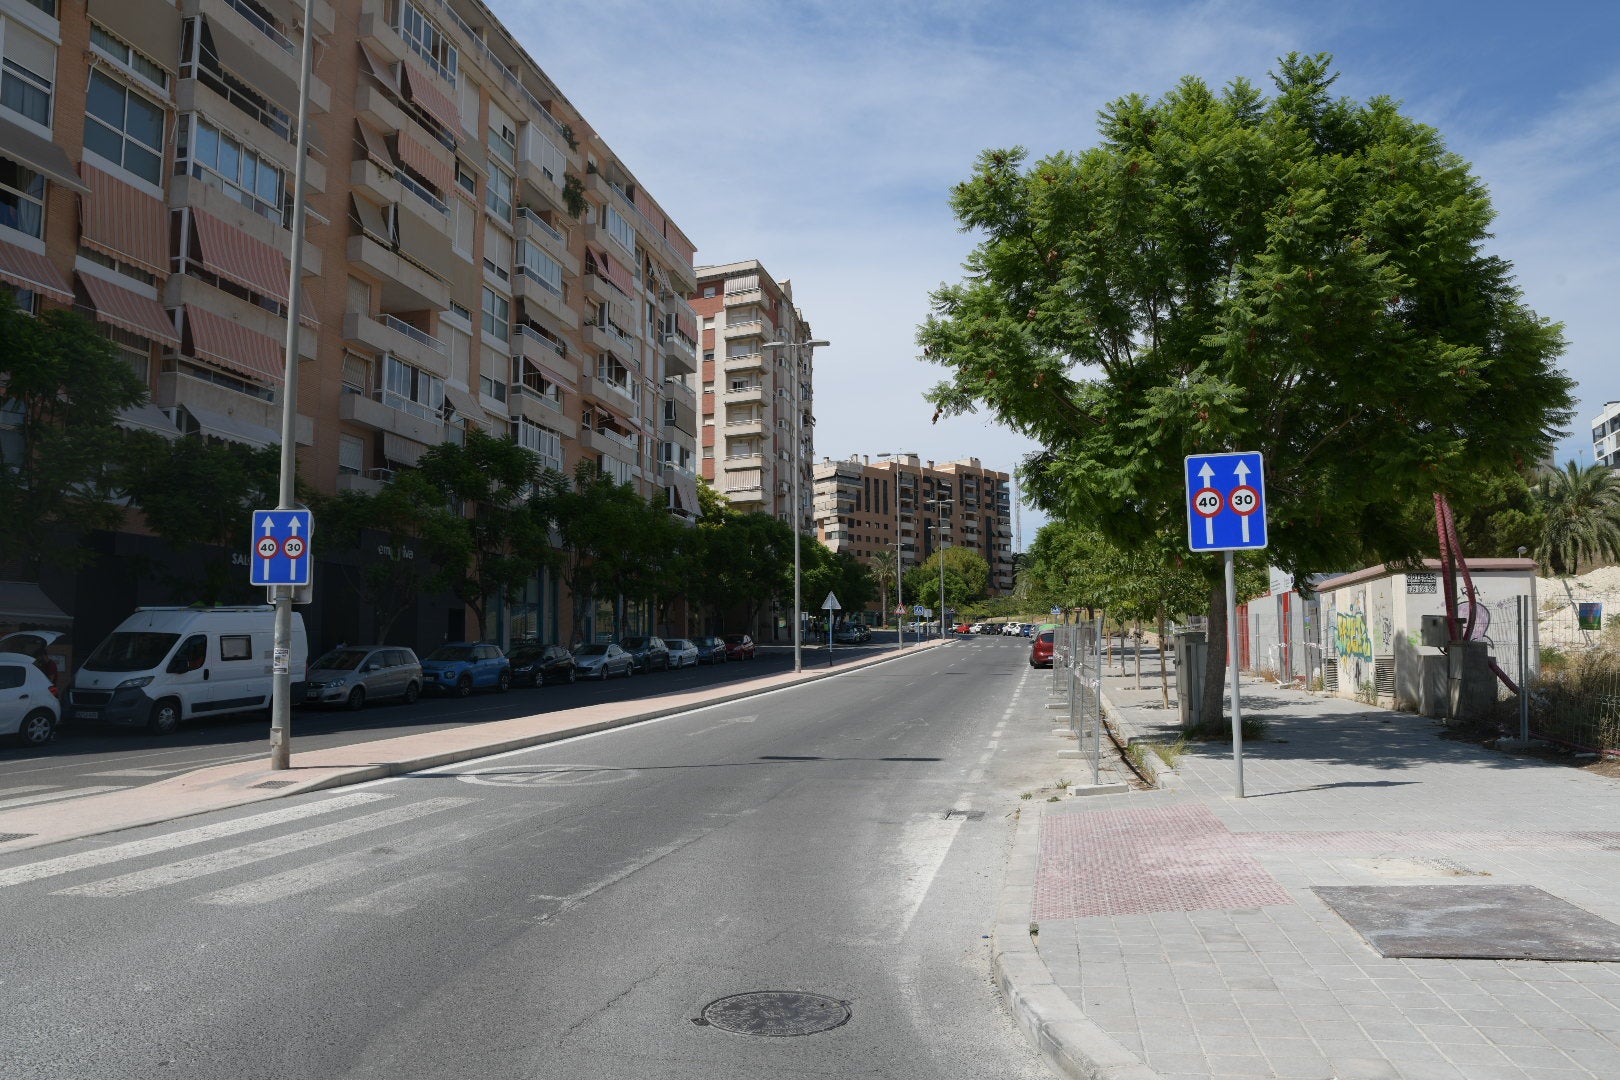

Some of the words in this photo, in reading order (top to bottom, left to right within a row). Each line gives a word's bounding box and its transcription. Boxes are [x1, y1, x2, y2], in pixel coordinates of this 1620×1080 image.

[1198, 496, 1218, 507] 40
[1234, 494, 1253, 506] 30
[260, 543, 275, 552] 40
[287, 543, 301, 552] 30
